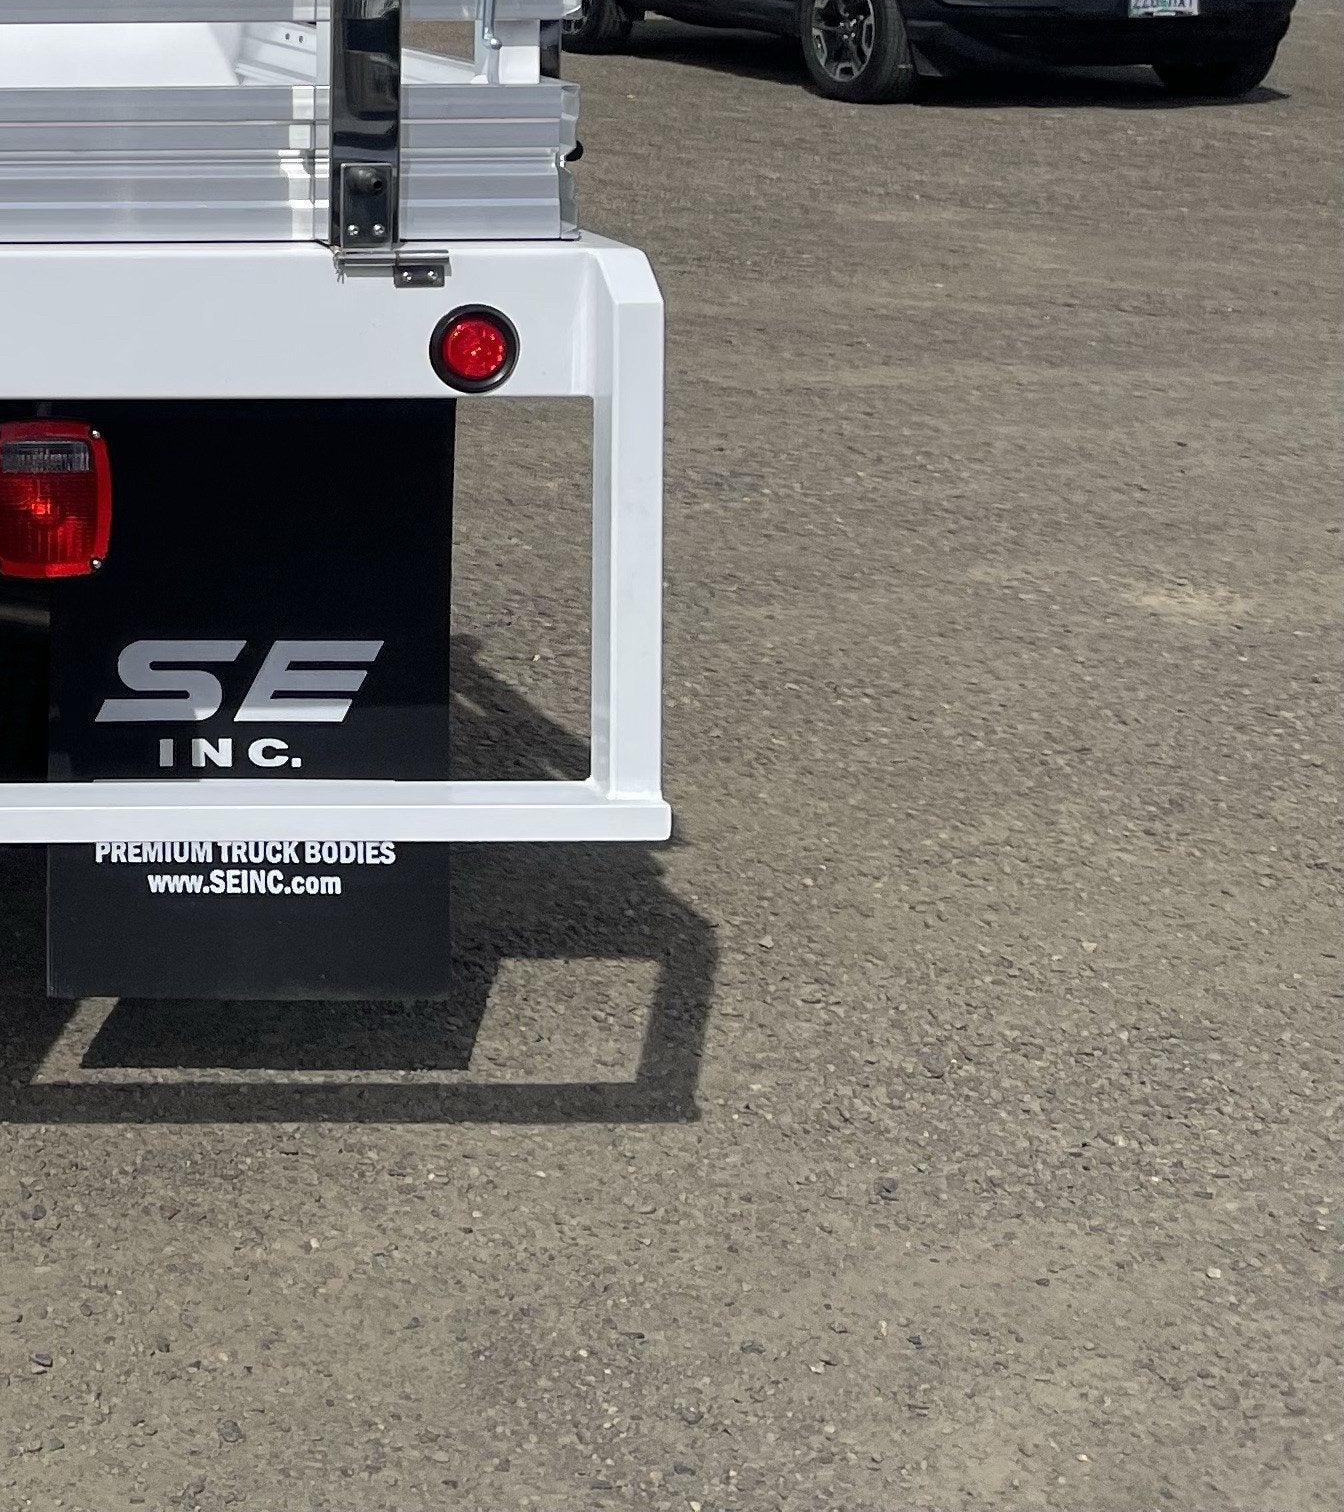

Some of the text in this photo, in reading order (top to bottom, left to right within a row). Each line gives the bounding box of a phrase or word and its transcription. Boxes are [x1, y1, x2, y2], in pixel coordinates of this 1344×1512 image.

[94, 639, 385, 723] SE
[159, 737, 302, 768] INC.
[94, 841, 397, 866] PREMIUM TRUCK BODIES
[147, 869, 342, 896] www.SEINC.com
